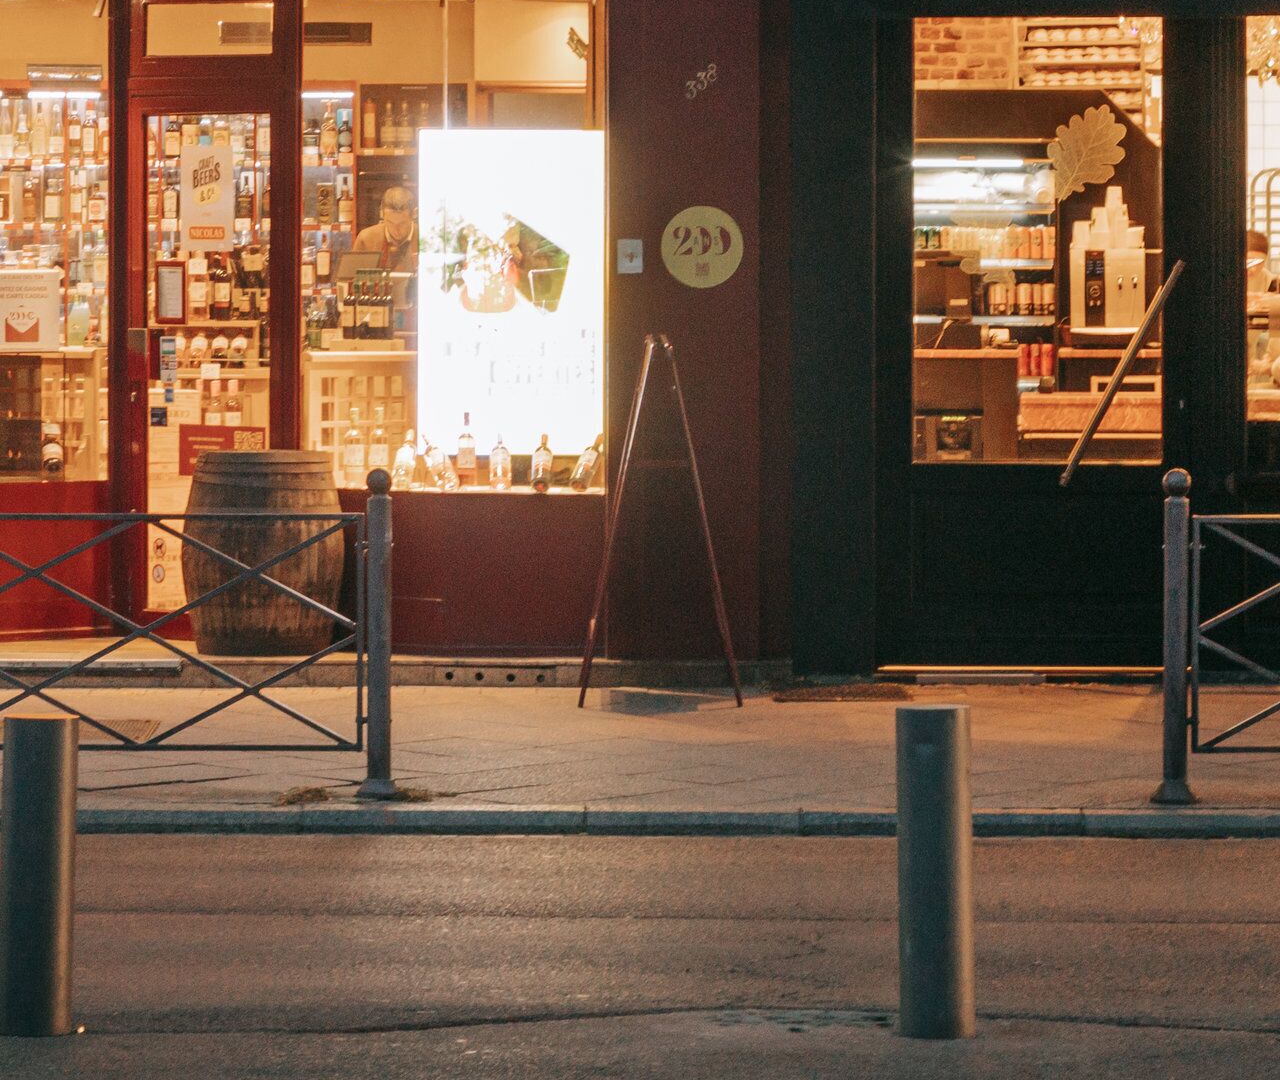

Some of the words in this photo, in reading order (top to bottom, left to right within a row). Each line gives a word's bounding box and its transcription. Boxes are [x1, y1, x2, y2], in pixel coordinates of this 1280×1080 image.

[684, 63, 719, 100] 338
[192, 162, 221, 190] BEERS
[190, 228, 223, 238] NICOLAS
